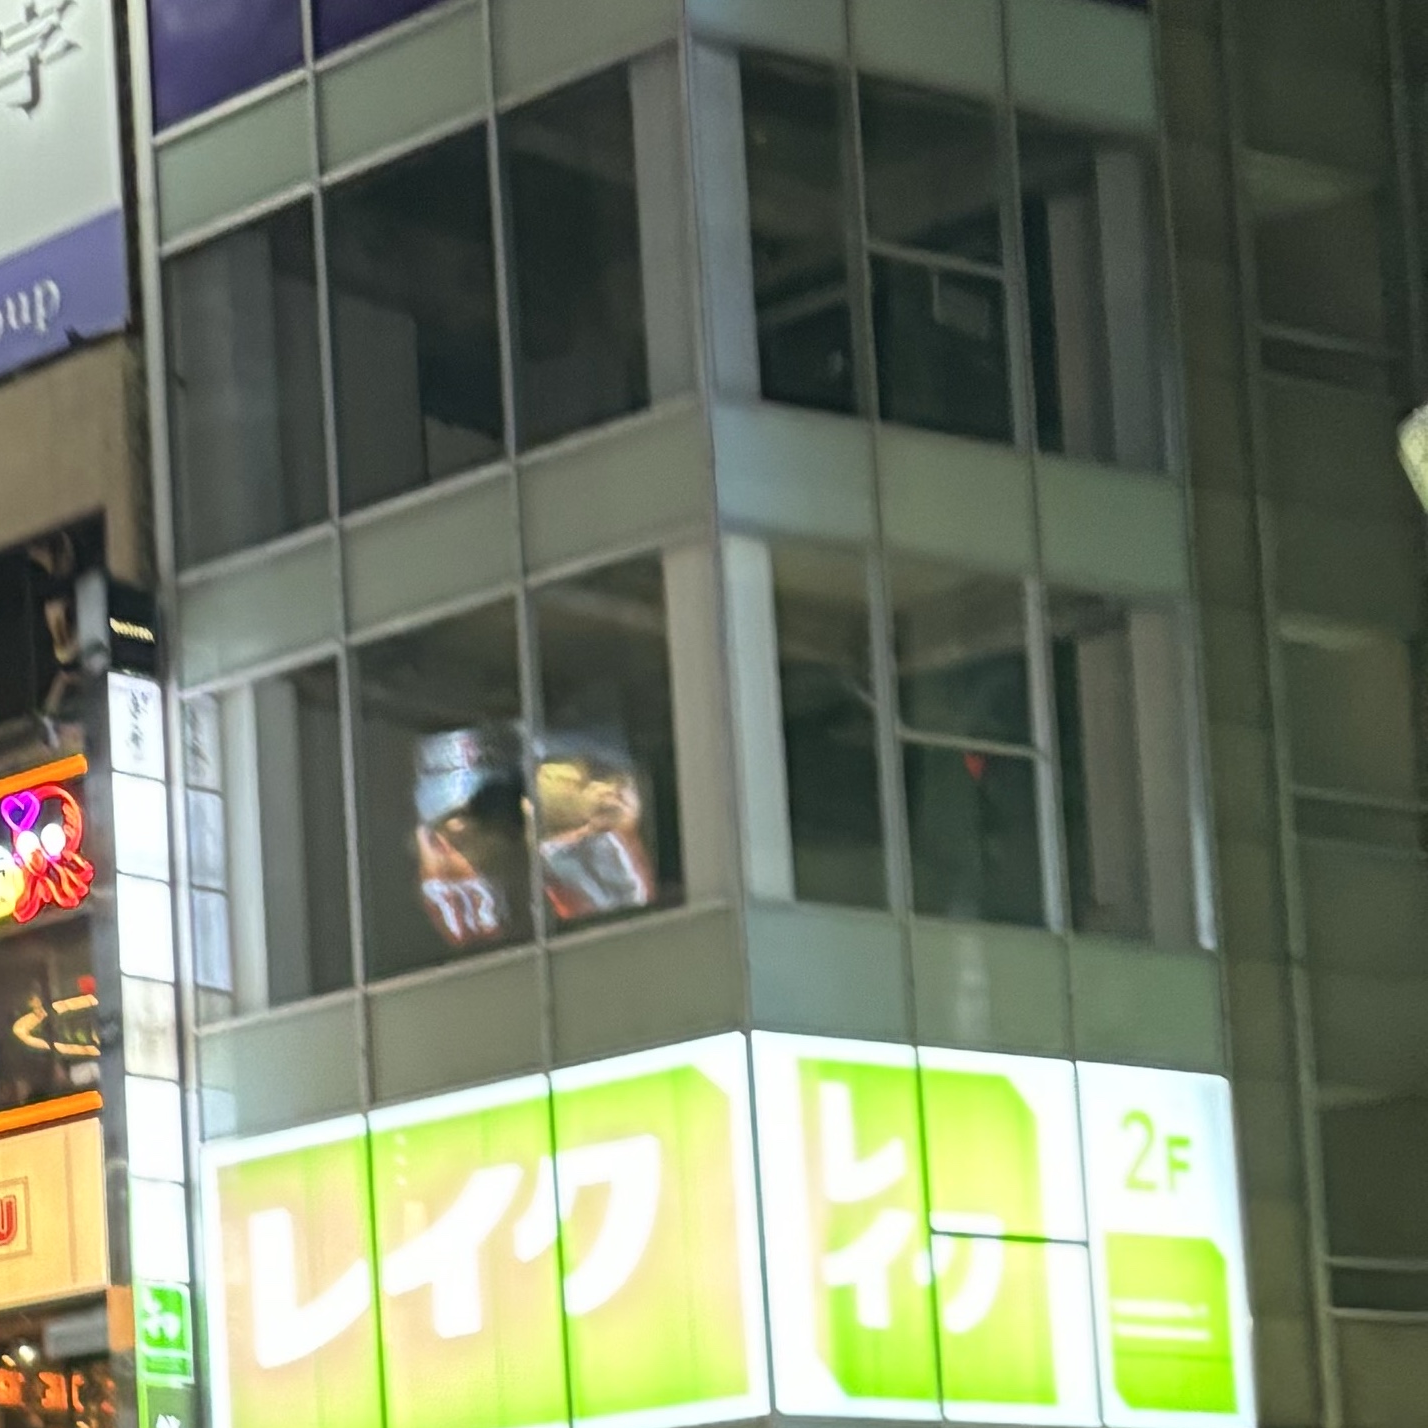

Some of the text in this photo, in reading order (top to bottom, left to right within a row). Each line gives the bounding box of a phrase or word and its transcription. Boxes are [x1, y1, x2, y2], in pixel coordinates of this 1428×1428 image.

[1121, 1108, 1194, 1194] 2F
[248, 1132, 663, 1371] レイク
